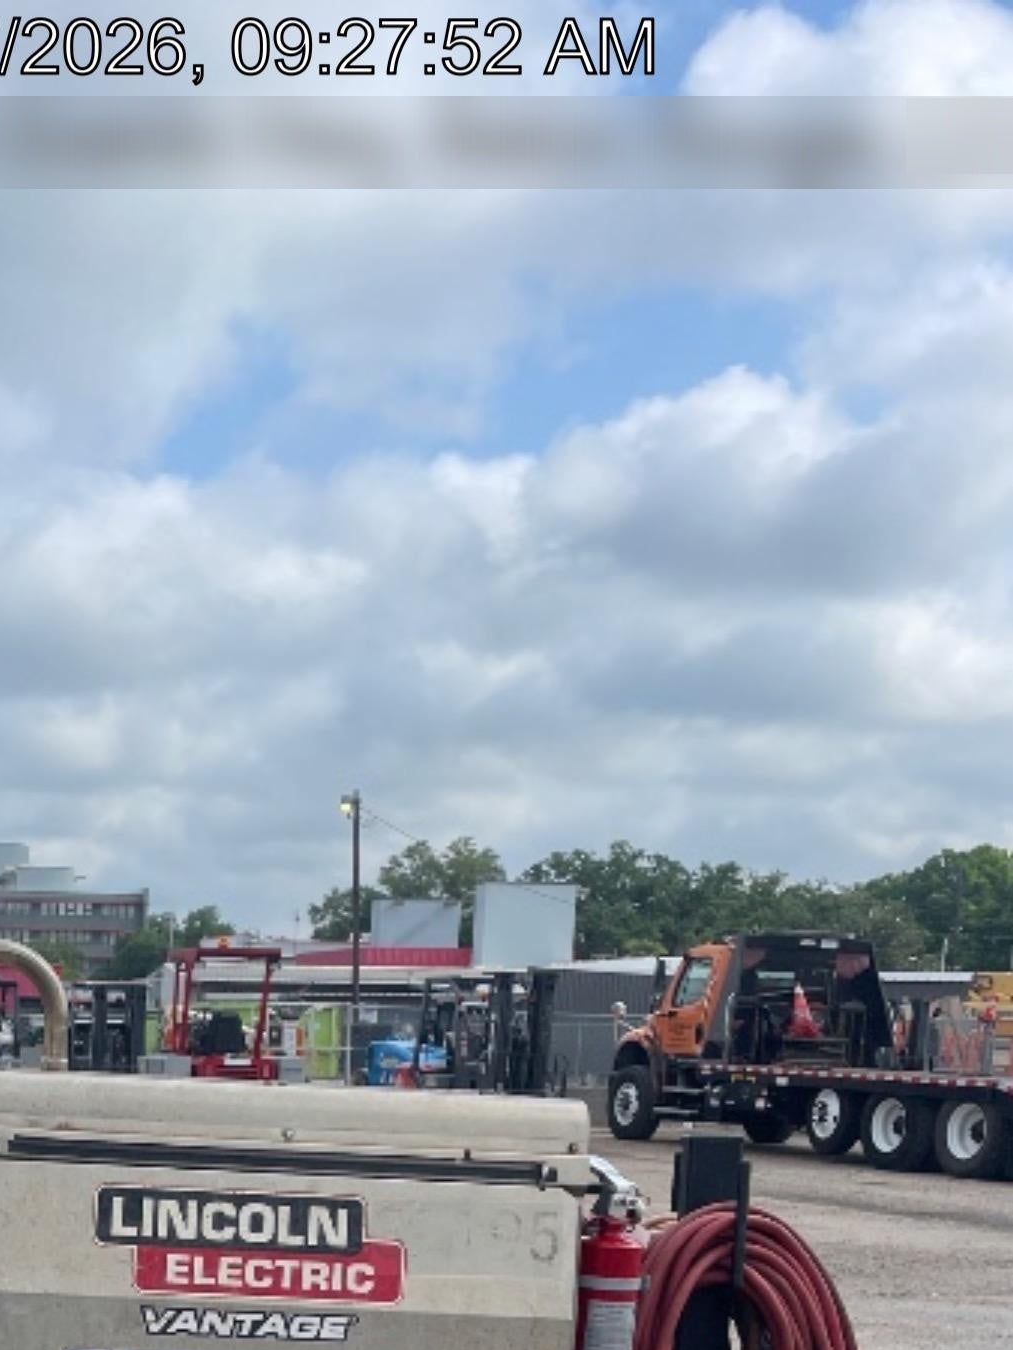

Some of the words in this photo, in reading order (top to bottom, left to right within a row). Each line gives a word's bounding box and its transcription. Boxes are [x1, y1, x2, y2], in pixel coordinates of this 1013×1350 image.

[109, 1196, 349, 1249] LINCOLN
[165, 1253, 376, 1295] ELECTRIC
[141, 1306, 351, 1341] VANTAGE
